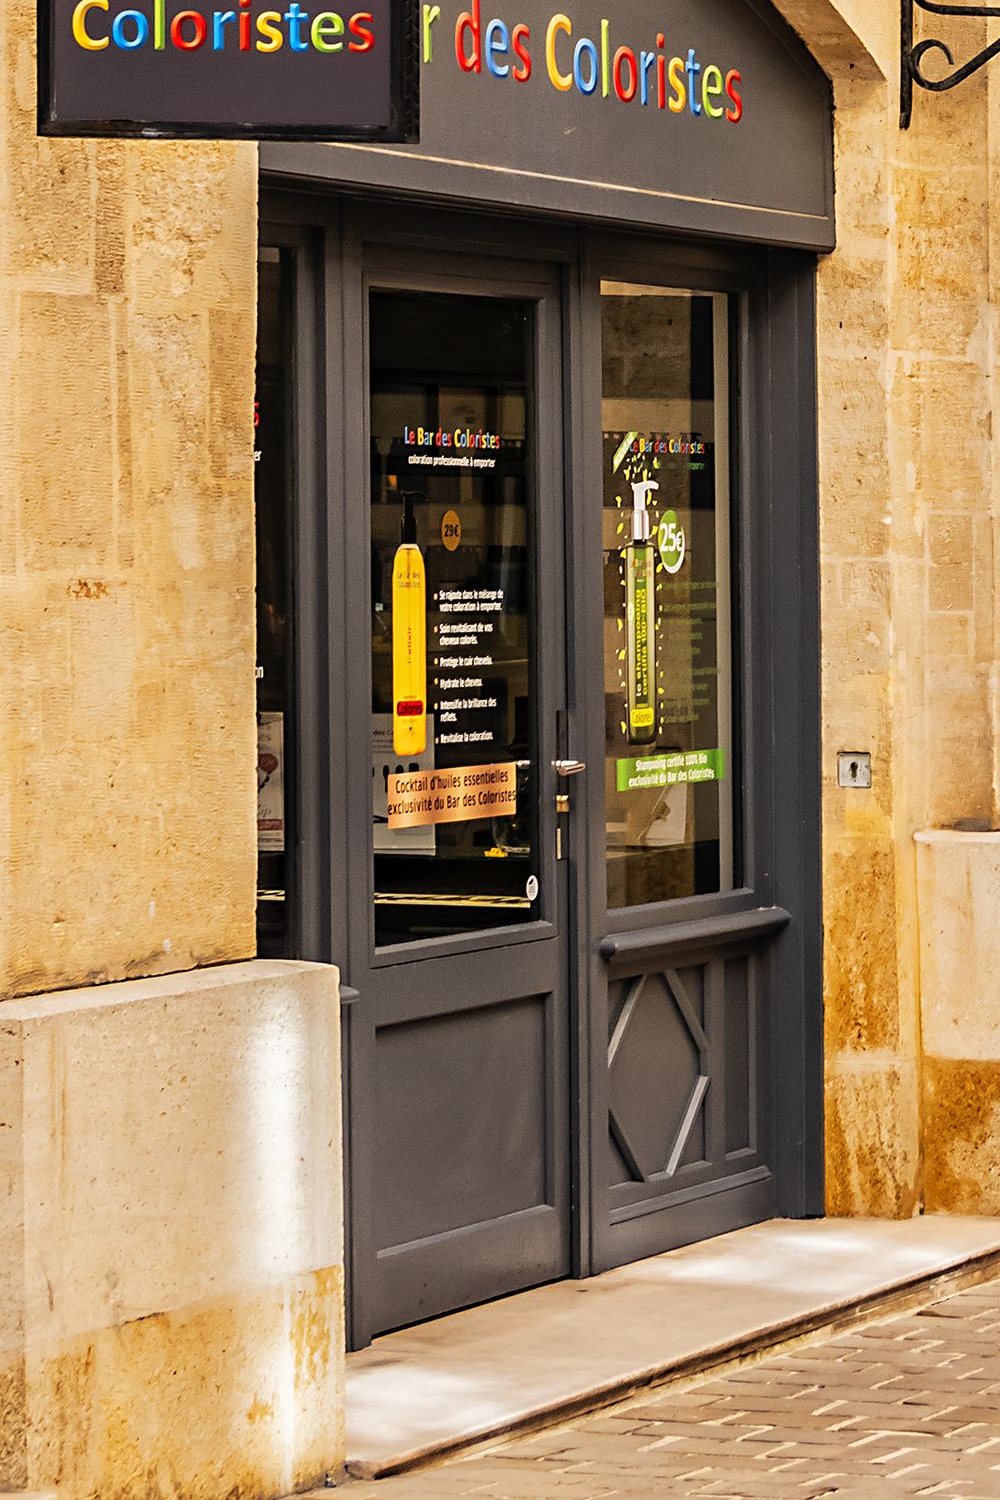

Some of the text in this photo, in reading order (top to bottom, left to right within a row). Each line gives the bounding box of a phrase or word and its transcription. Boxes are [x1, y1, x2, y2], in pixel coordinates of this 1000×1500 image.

[546, 14, 743, 124] Coloristes
[404, 426, 500, 449] Le Bar des Coloristes
[640, 438, 653, 453] Bar
[654, 438, 668, 453] des
[668, 438, 705, 454] Coloristes
[444, 524, 459, 538] 29€
[660, 523, 683, 552] 25€
[395, 769, 508, 794] Cocktail d'huiles essentielles
[388, 789, 516, 815] exclusivité du Bar des Coloristes
